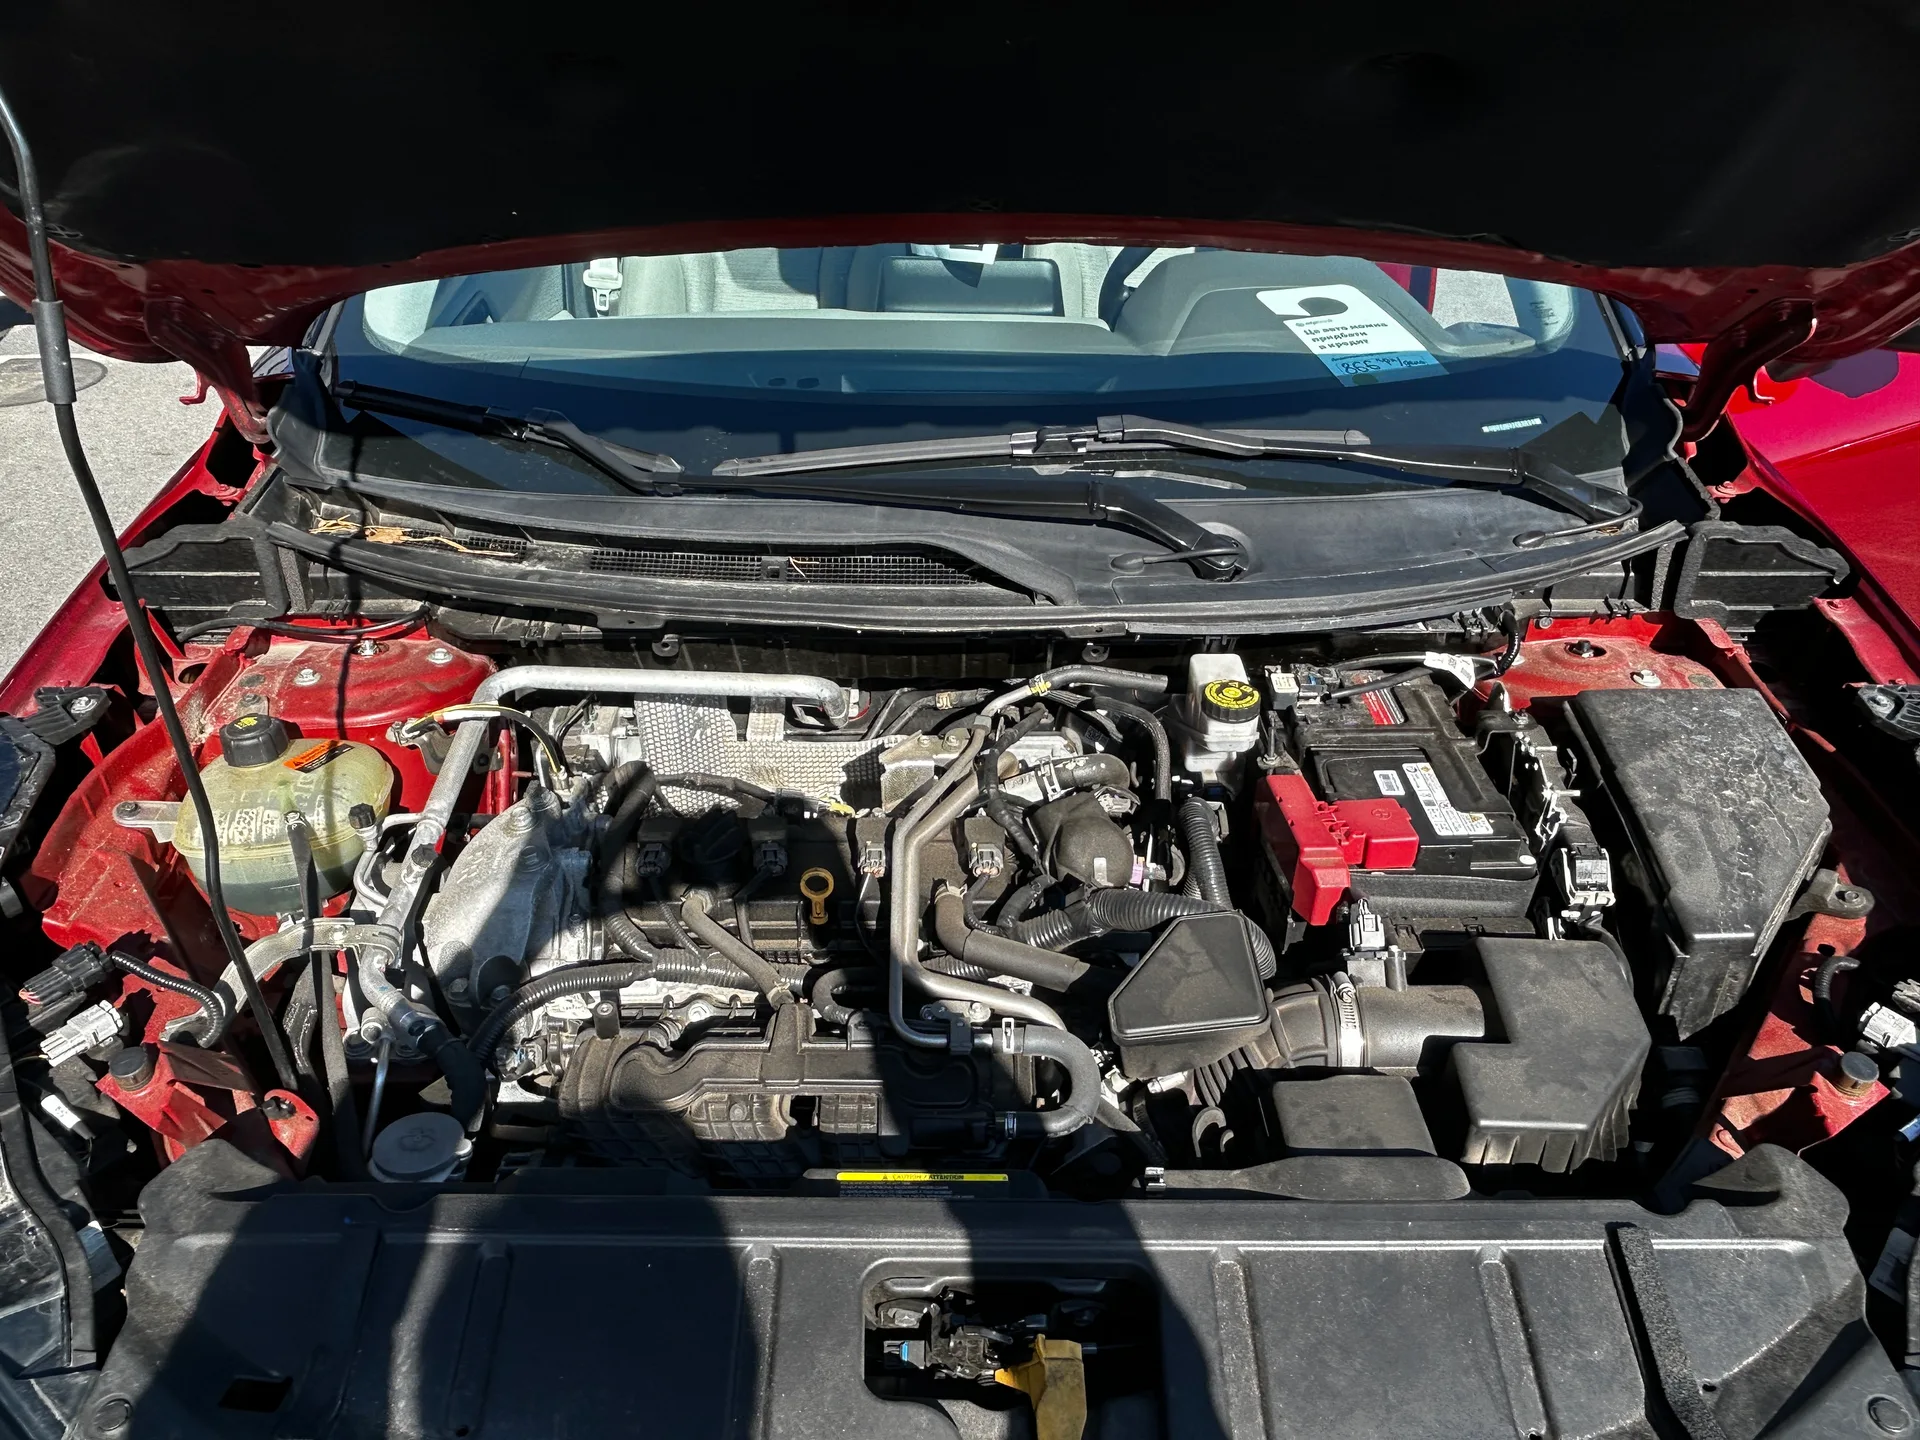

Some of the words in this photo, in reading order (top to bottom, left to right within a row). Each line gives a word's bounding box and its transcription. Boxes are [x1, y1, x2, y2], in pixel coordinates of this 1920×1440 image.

[1349, 322, 1388, 330] можна
[1311, 332, 1368, 343] придбати
[1327, 338, 1369, 349] кредит
[1342, 361, 1381, 375] 866
